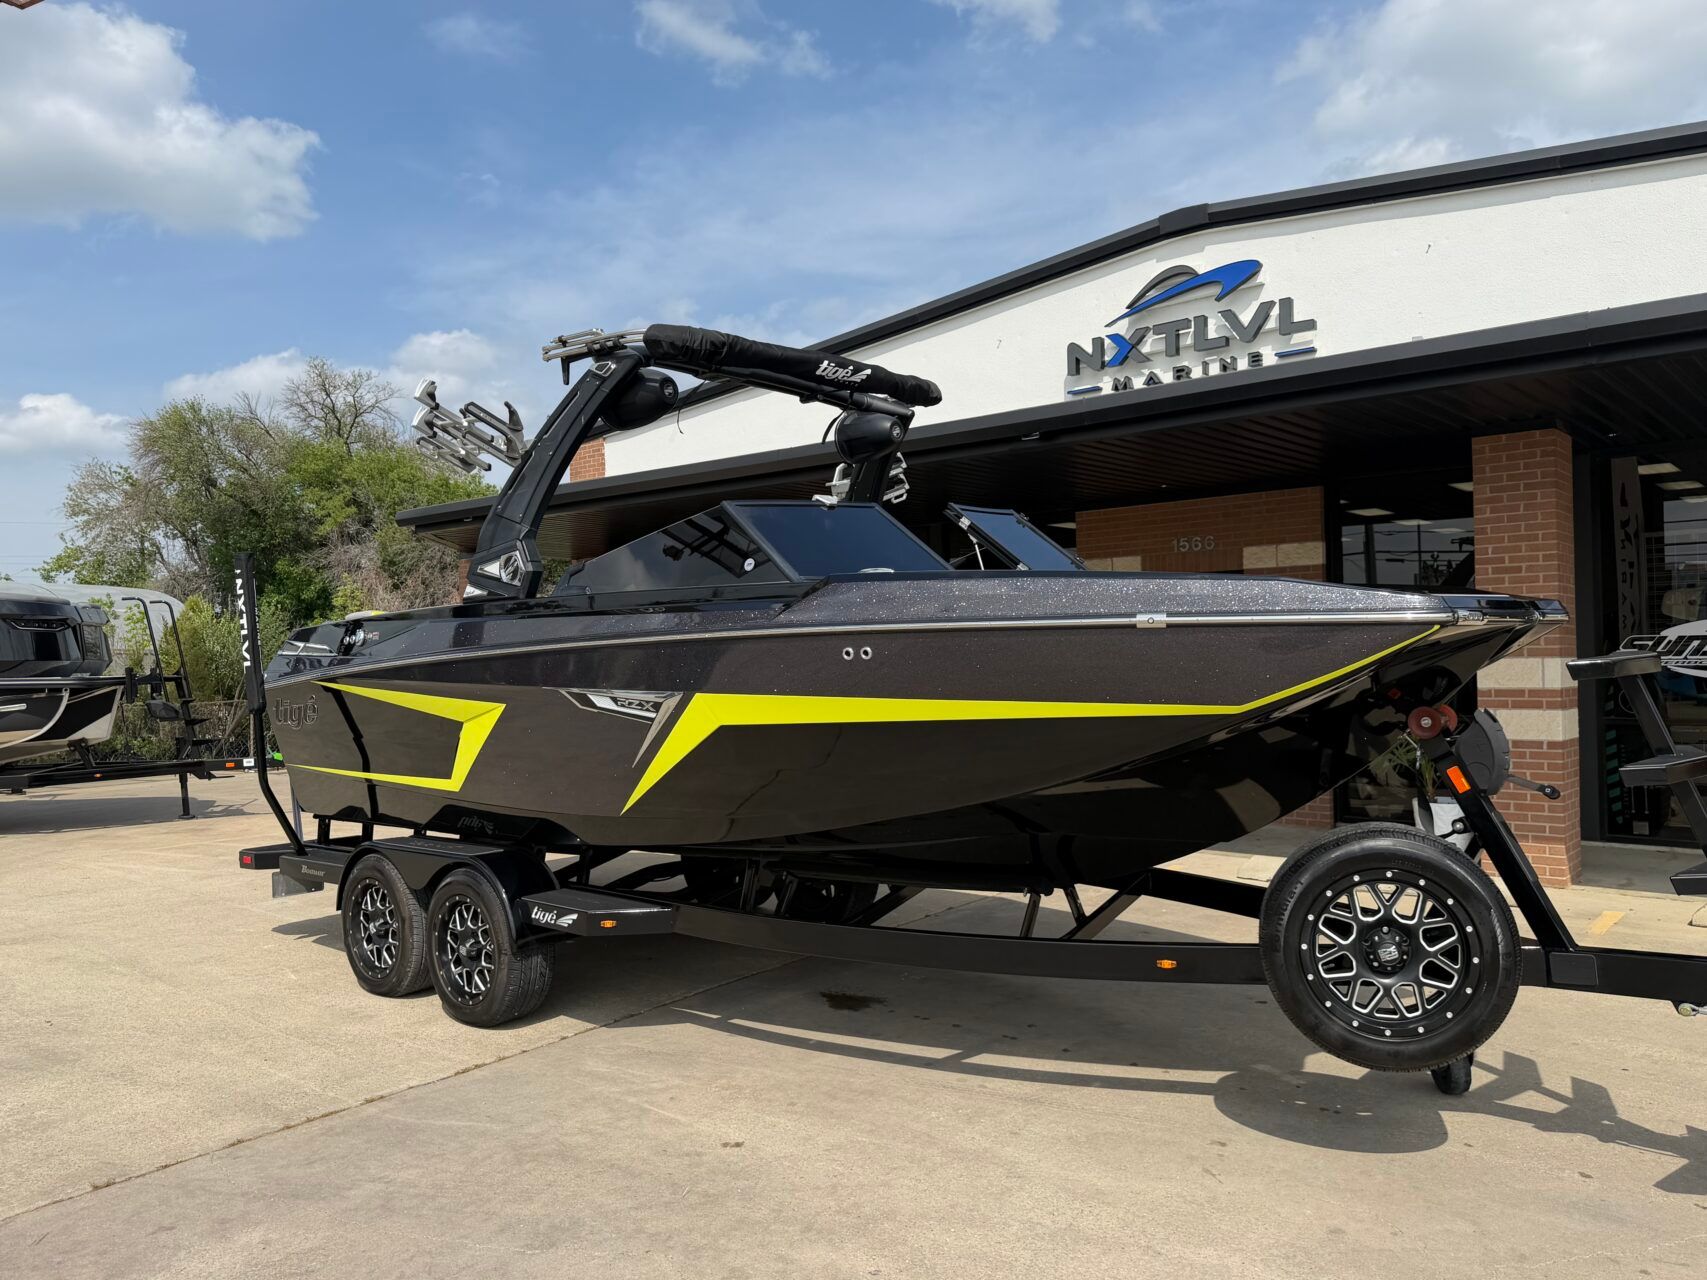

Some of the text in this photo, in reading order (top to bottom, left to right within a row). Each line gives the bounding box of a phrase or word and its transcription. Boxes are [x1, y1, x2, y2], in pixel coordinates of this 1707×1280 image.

[1067, 297, 1317, 376] NXTLVL
[815, 360, 853, 380] tigé
[1111, 351, 1263, 392] MARINE
[1171, 535, 1215, 552] 1566
[272, 694, 319, 730] tigé
[531, 906, 557, 924] tigé
